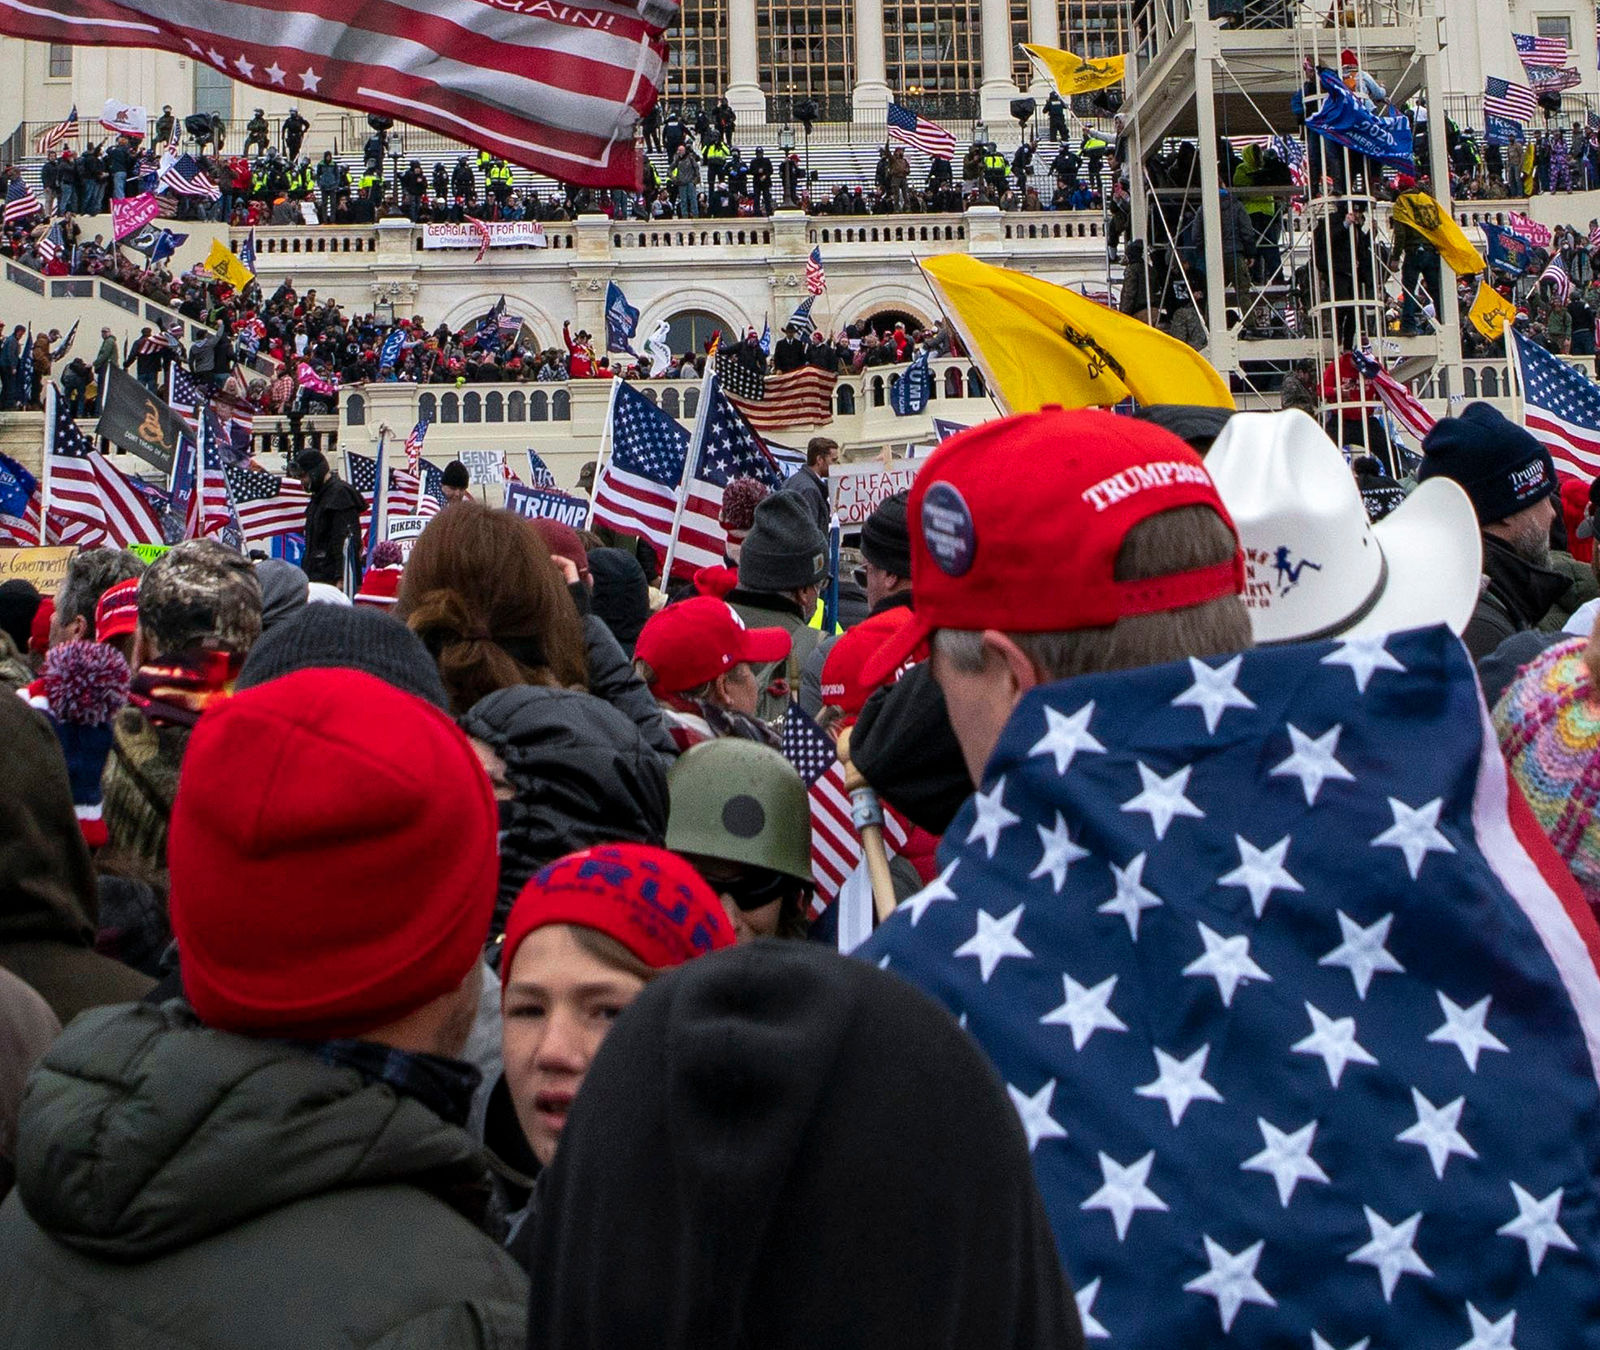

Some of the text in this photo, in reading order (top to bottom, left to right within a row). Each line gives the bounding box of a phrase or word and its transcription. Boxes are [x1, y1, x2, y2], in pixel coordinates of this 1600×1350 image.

[428, 225, 467, 237] GEORGIA
[496, 225, 514, 236] FOR
[497, 235, 534, 244] Republicans
[161, 453, 171, 462] ME
[462, 451, 498, 465] SEND
[1509, 459, 1544, 485] Trump
[473, 474, 500, 485] JAIL
[512, 492, 588, 528] TRUMP
[390, 519, 422, 535] BIKERS
